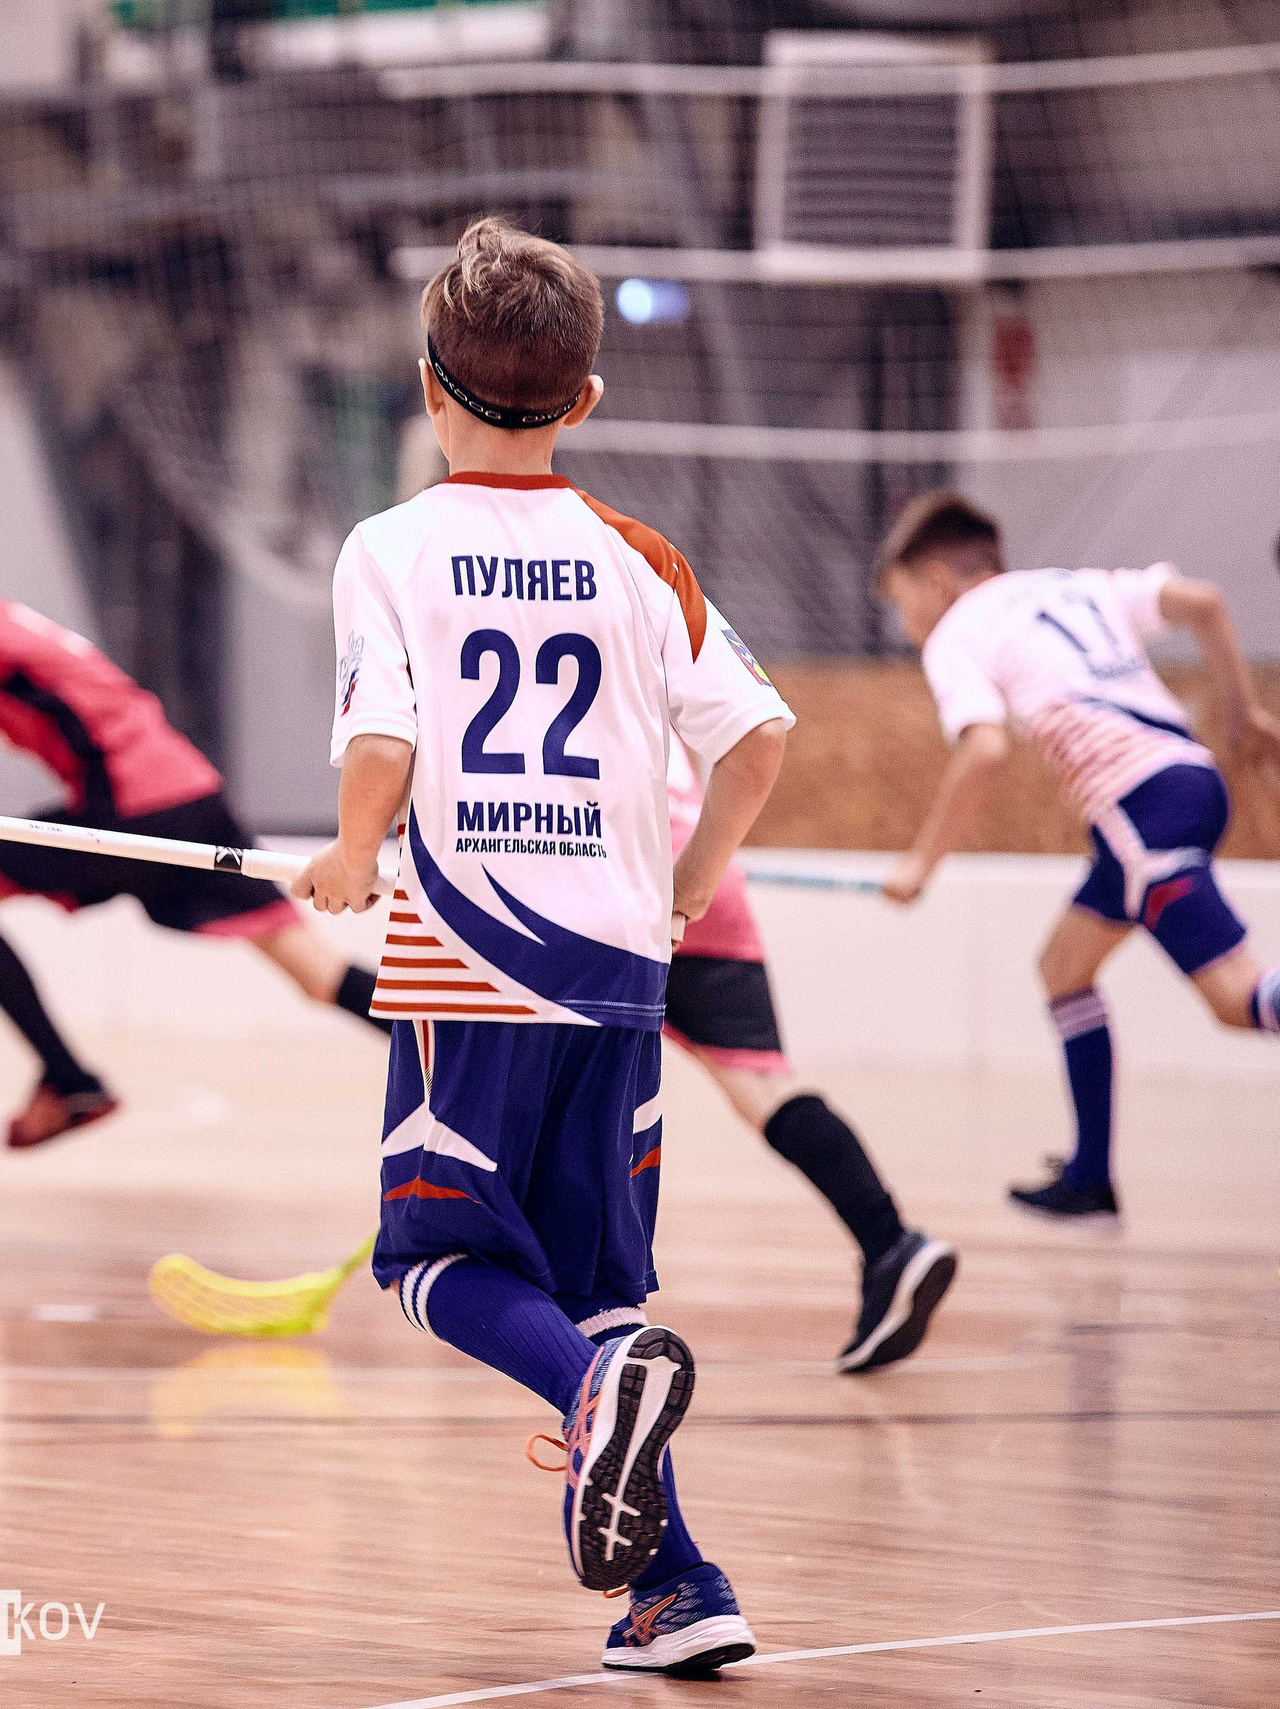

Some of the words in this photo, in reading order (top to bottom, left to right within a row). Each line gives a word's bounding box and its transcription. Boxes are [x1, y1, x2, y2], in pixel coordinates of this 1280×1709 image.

[451, 555, 598, 602] ПУЛЯЕВ
[460, 628, 602, 780] 22
[457, 800, 602, 838] МИРНЫЙ
[455, 838, 556, 856] АРХАНГЕЛЬСКАЯ
[558, 840, 607, 859] ОБЛАСТЬ
